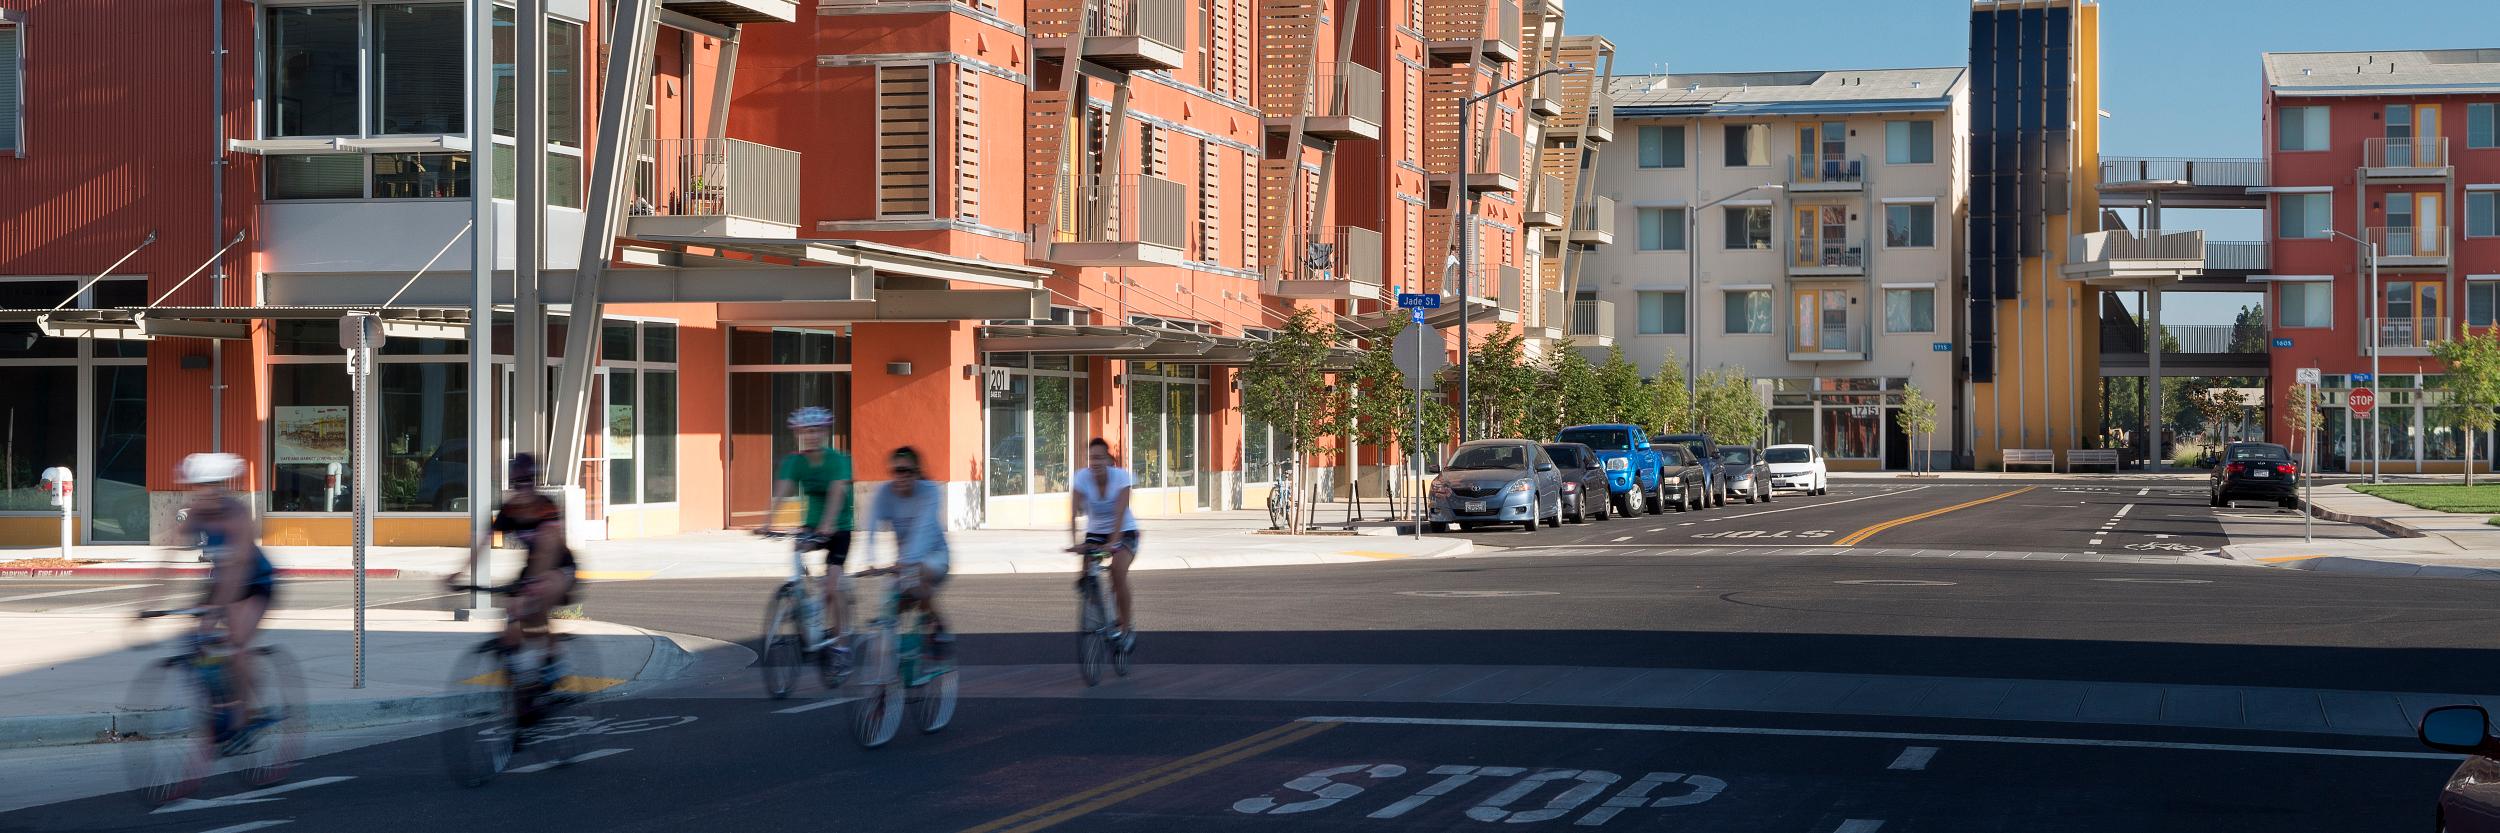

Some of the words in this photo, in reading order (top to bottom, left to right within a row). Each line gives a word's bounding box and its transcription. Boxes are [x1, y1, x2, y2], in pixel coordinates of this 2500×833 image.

[1403, 297, 1423, 306] Jade
[1425, 297, 1436, 306] St.
[990, 369, 1005, 391] 201
[2350, 395, 2373, 406] STOP
[1854, 406, 1877, 417] 1715
[1690, 530, 1835, 538] STOP
[1232, 764, 1728, 826] STOP
